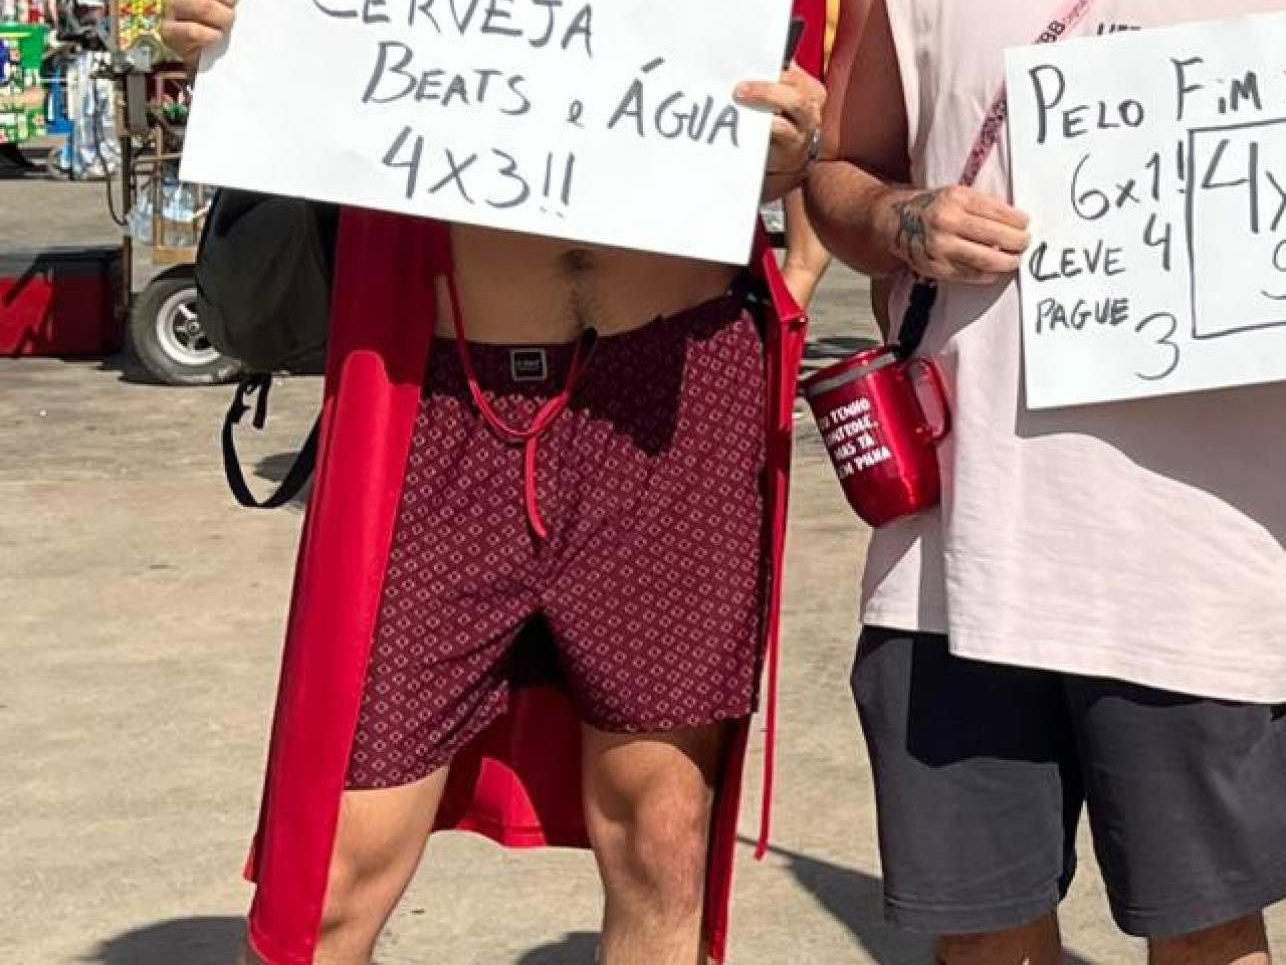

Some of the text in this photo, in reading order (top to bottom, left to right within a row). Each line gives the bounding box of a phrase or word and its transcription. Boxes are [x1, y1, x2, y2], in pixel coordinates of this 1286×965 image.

[361, 41, 740, 148] BEATS e ÁGUA
[1027, 64, 1146, 145] PELO
[1028, 214, 1174, 281] LEVE 4
[1035, 298, 1180, 381] PAGUE 3
